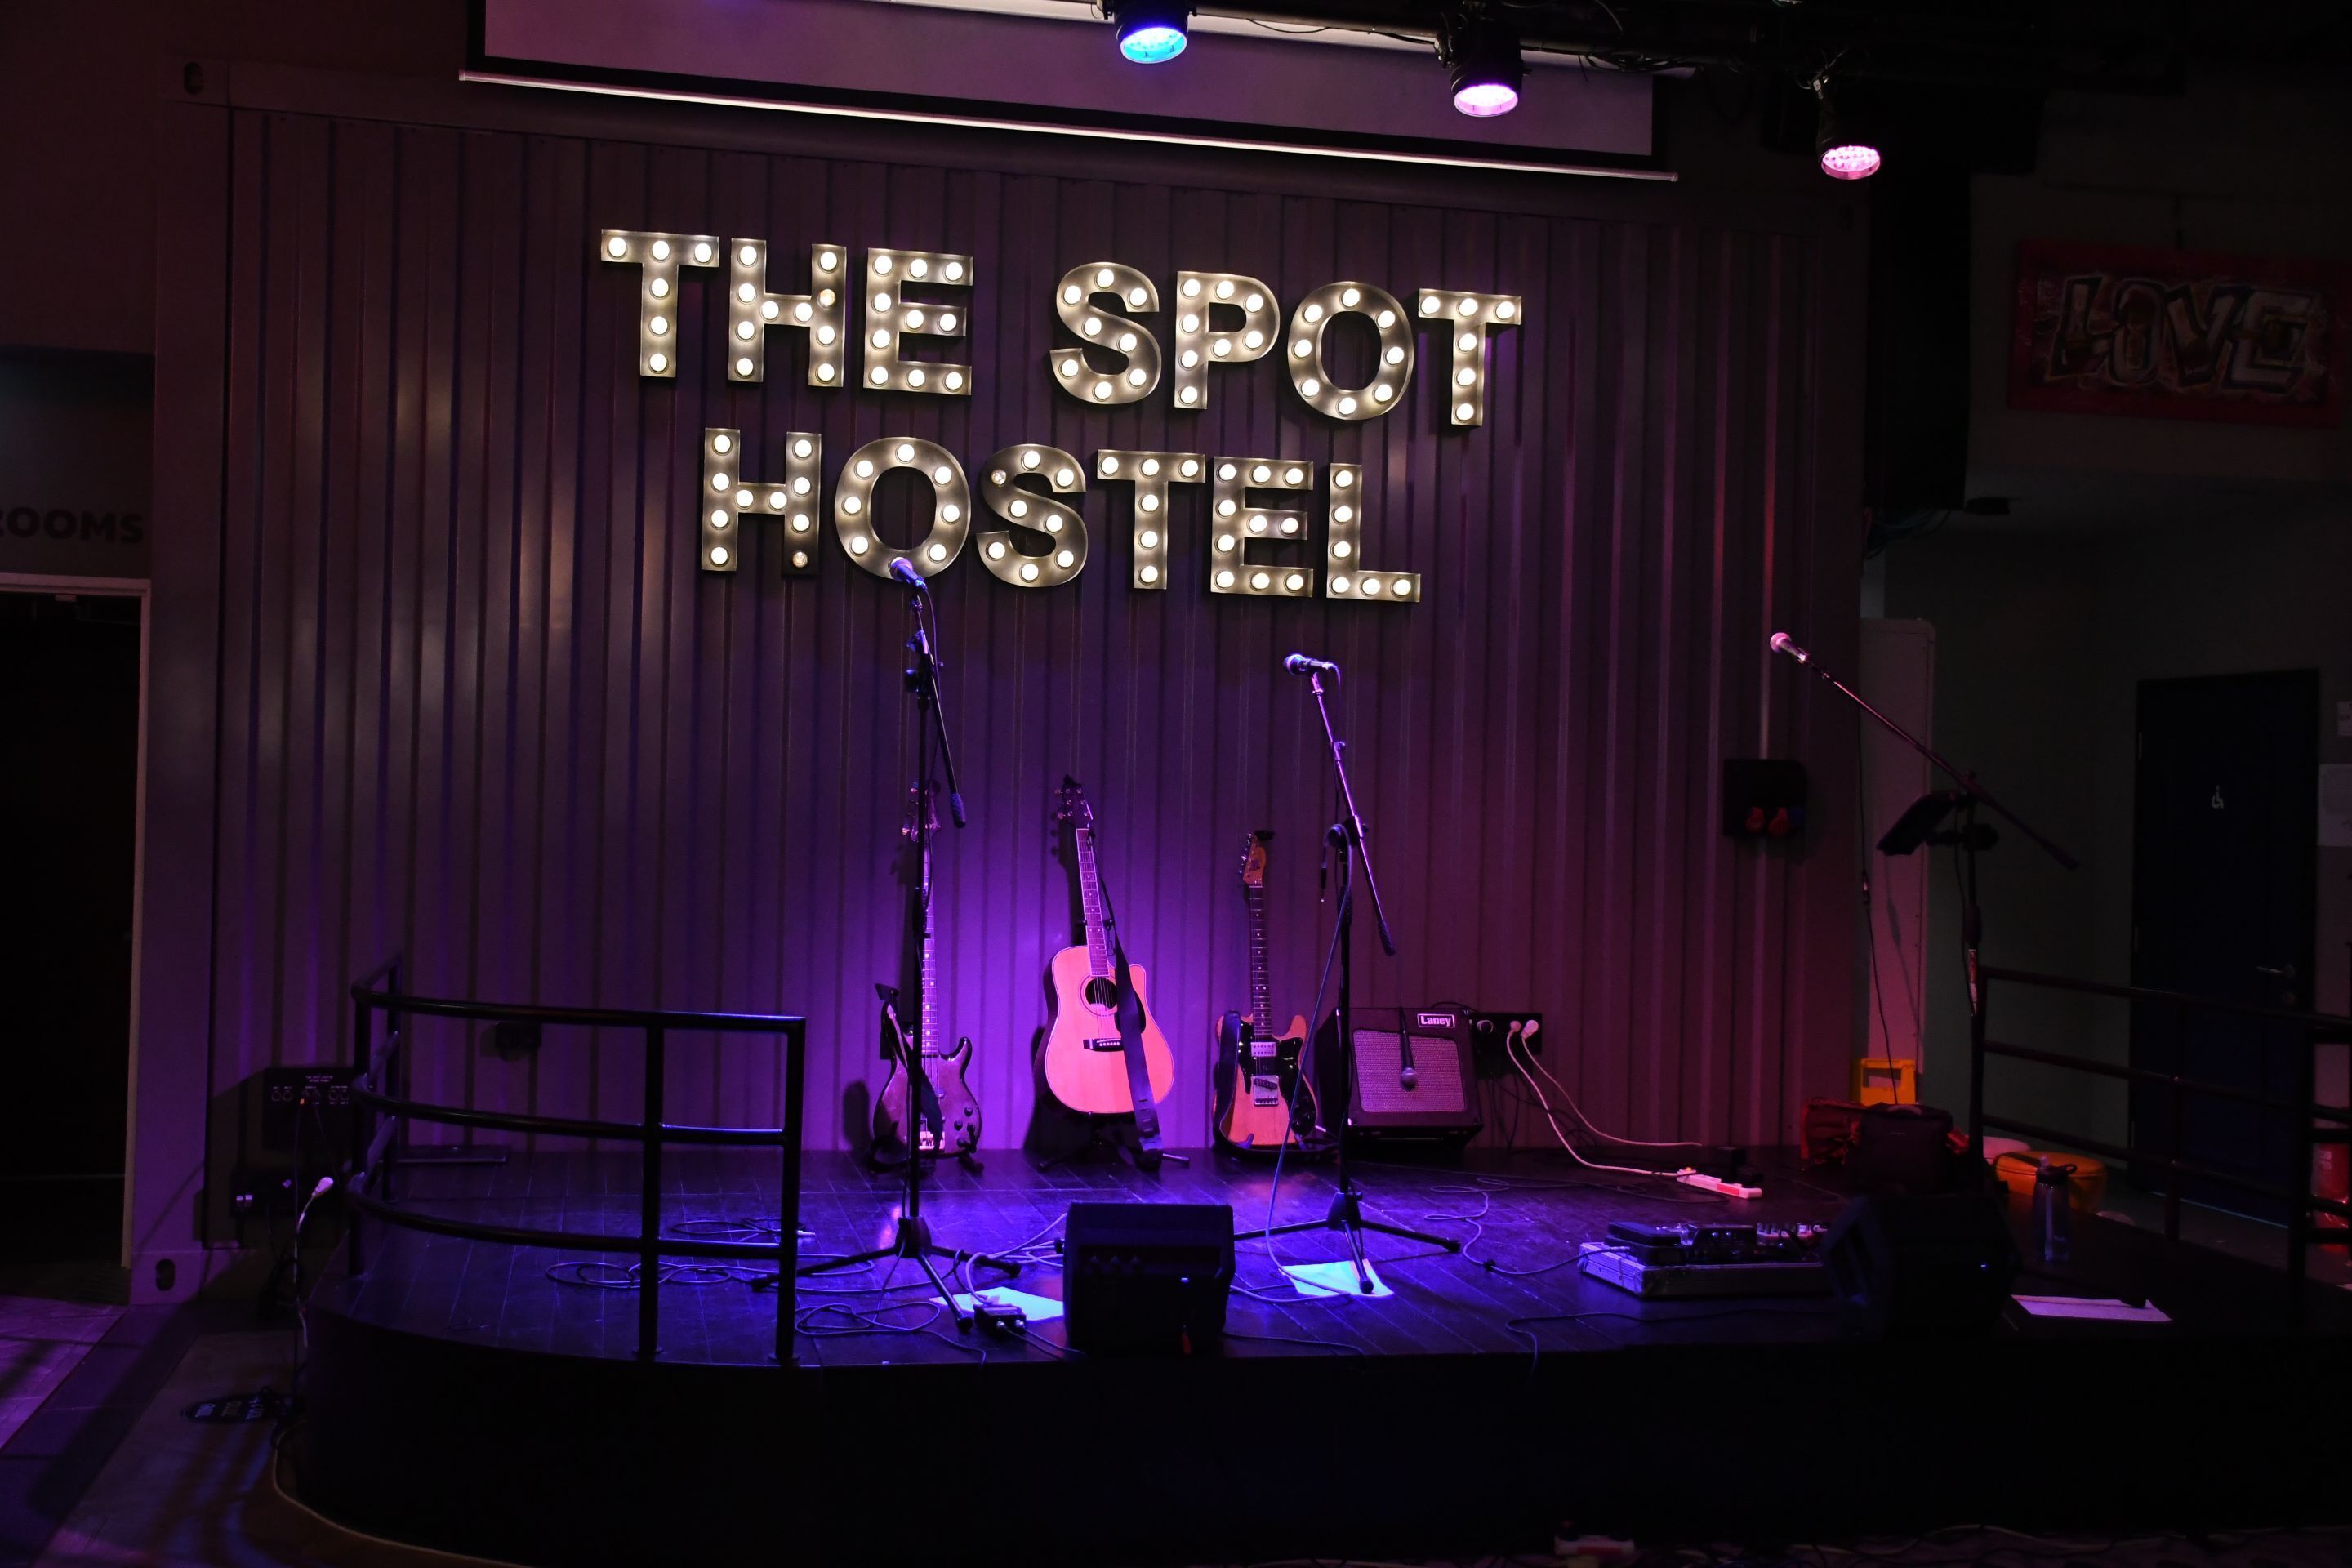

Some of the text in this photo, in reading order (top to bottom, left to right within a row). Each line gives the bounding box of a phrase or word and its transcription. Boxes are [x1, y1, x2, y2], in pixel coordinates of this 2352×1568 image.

[600, 229, 1523, 427] THE SPOT
[2044, 274, 2321, 395] LOVE
[0, 506, 143, 544] OOMS
[700, 427, 1421, 604] HOSTEL
[1420, 1015, 1451, 1027] Laney
